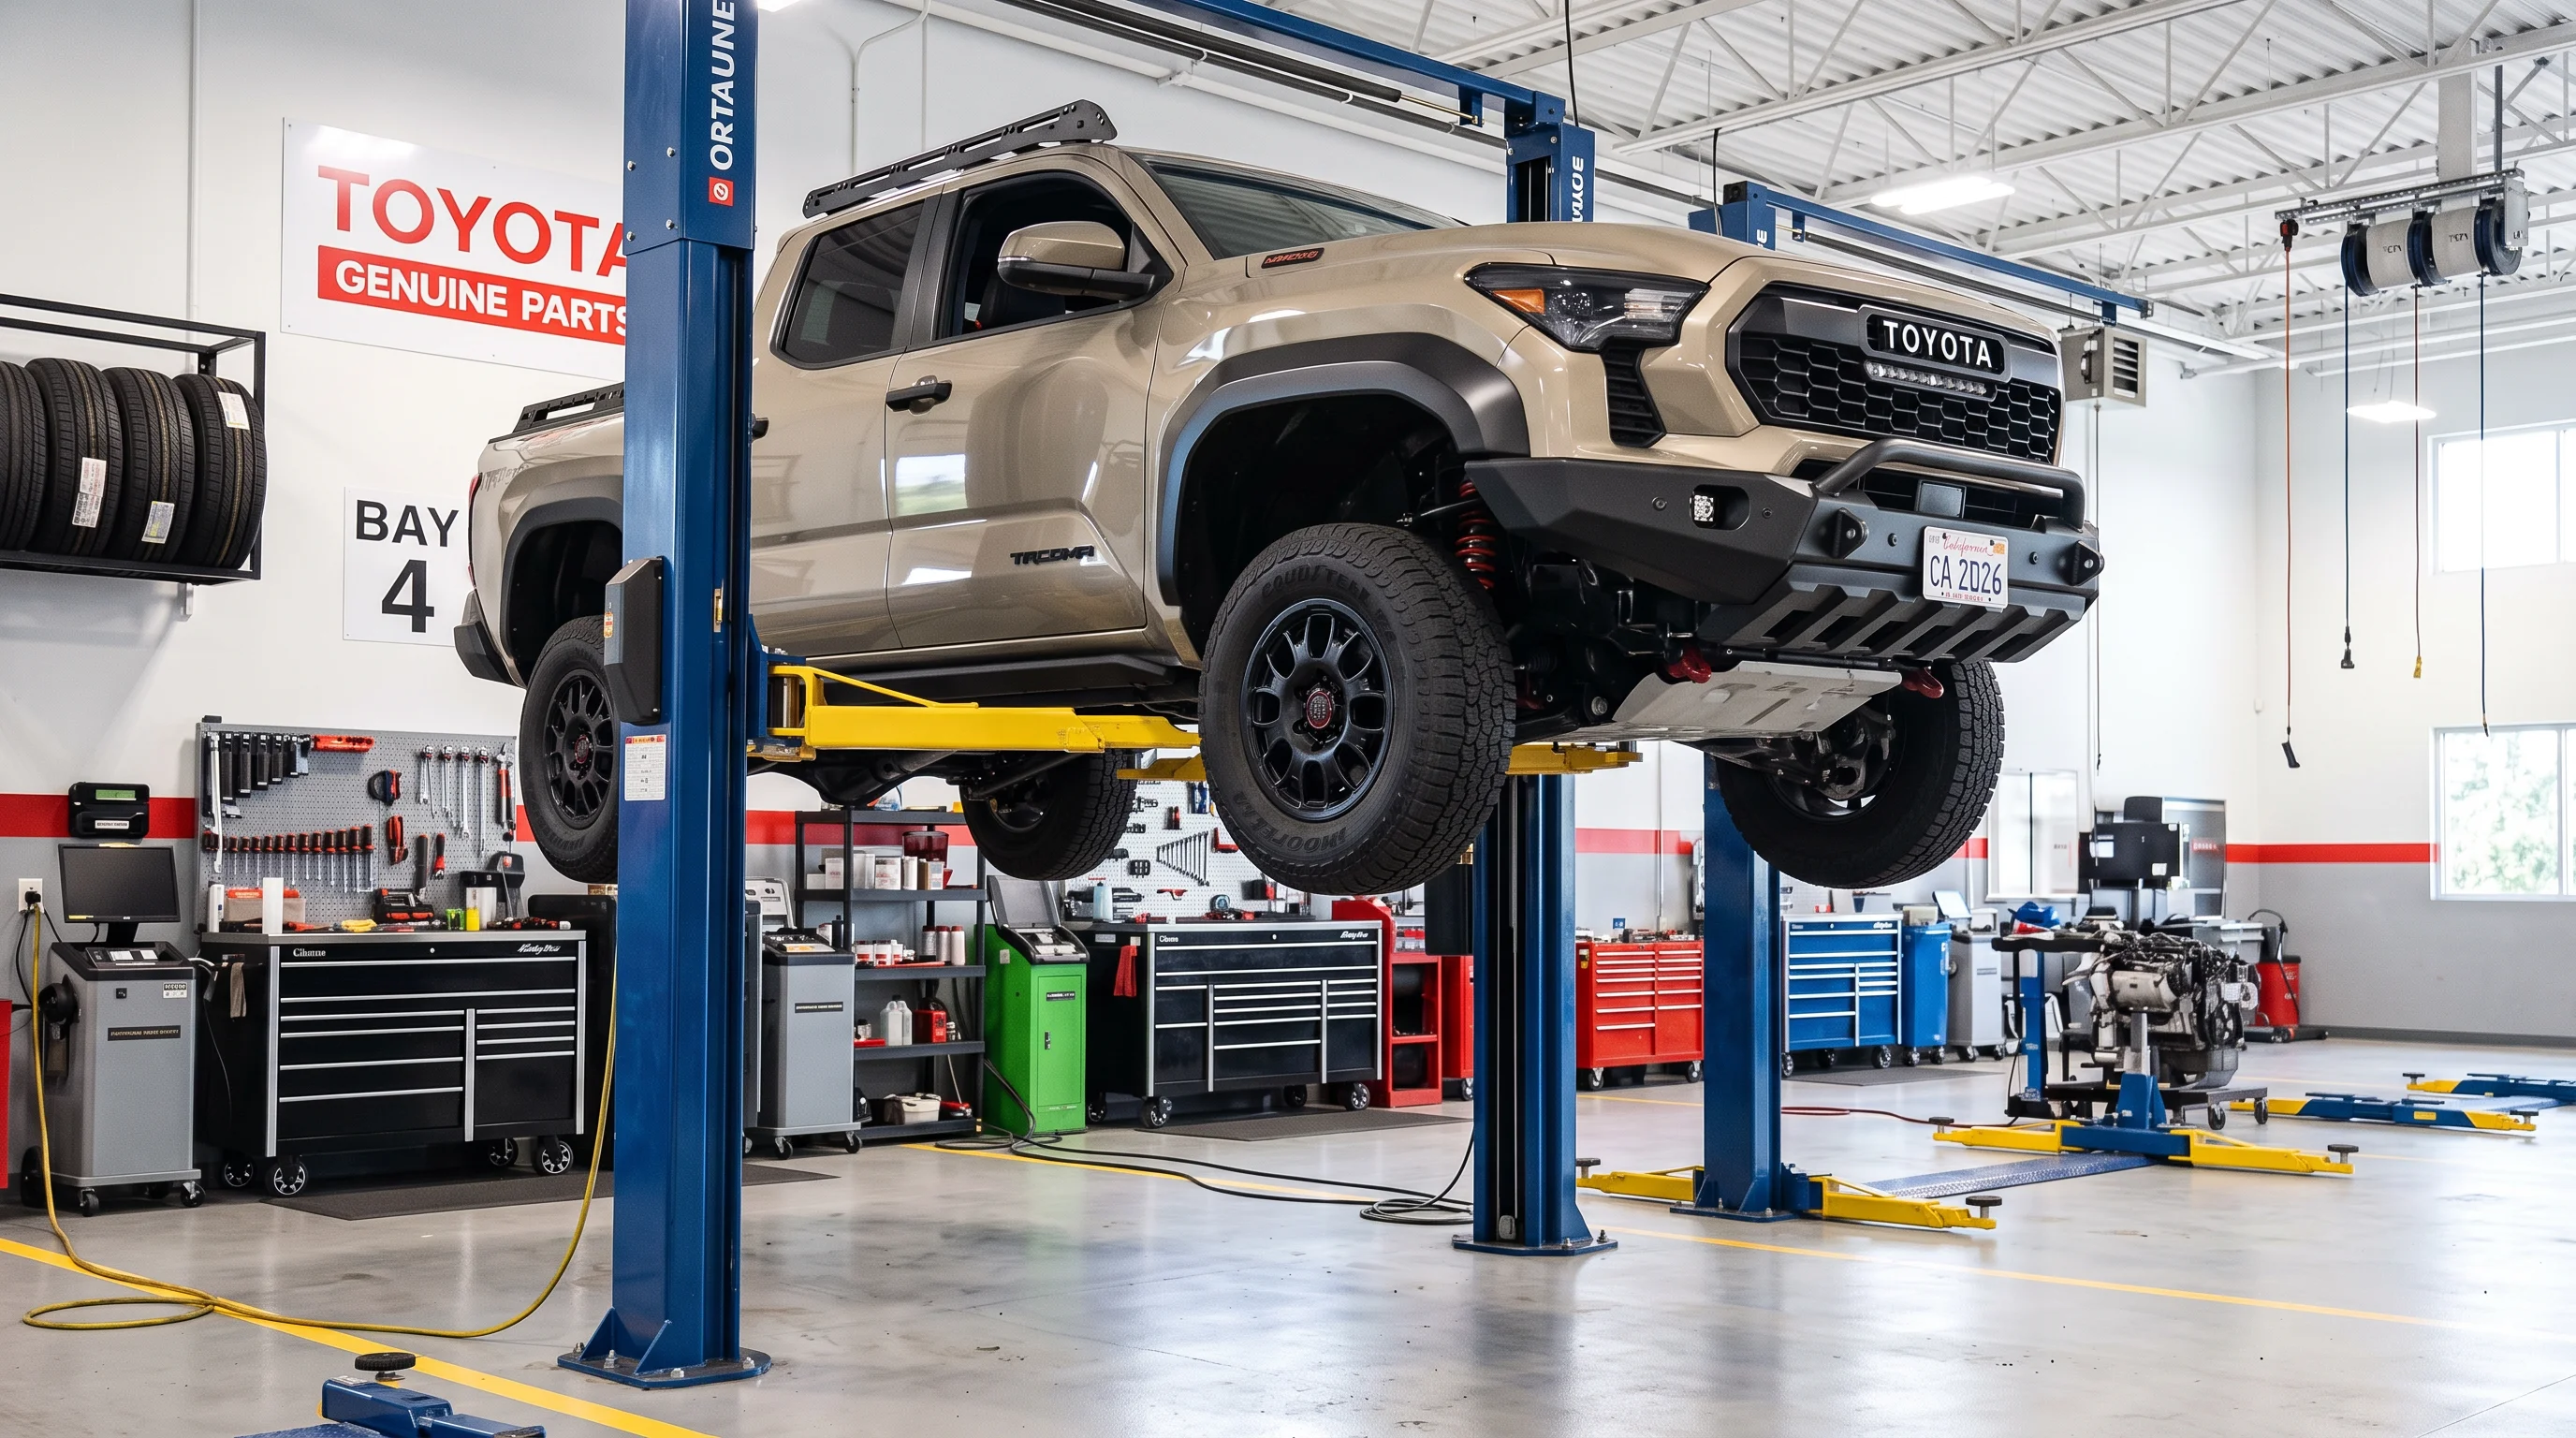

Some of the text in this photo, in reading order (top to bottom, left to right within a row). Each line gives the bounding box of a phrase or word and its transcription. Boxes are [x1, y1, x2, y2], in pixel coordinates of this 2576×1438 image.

[318, 165, 626, 277] TOYOTA
[335, 260, 508, 318] GENUINE
[1883, 320, 1992, 368] TOYOTA
[357, 500, 459, 547] BAY
[382, 559, 434, 633] 4
[1930, 555, 1953, 590] CA
